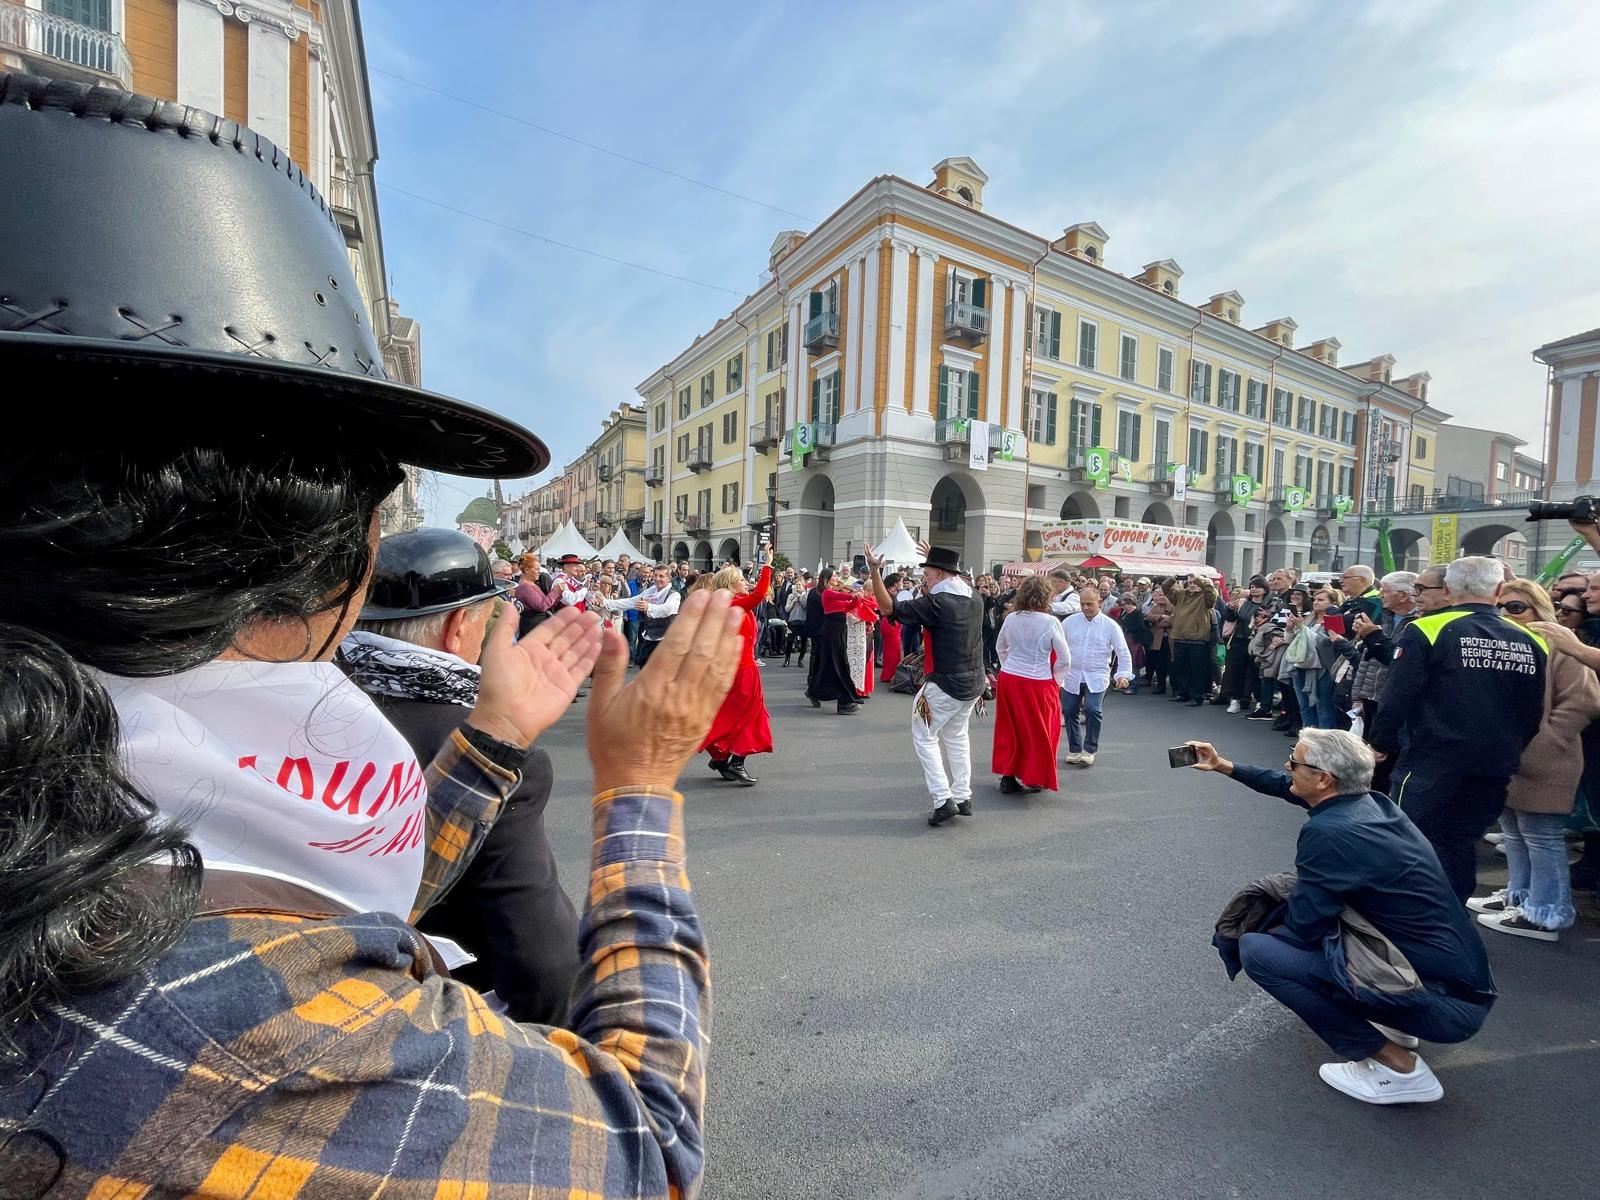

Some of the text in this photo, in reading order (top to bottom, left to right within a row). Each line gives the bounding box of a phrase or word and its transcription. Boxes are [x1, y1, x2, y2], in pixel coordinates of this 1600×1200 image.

[1460, 637, 1508, 650] PROTEZIONE
[1494, 650, 1535, 665] PIEMONTE
[1378, 1079, 1391, 1087] FILA
